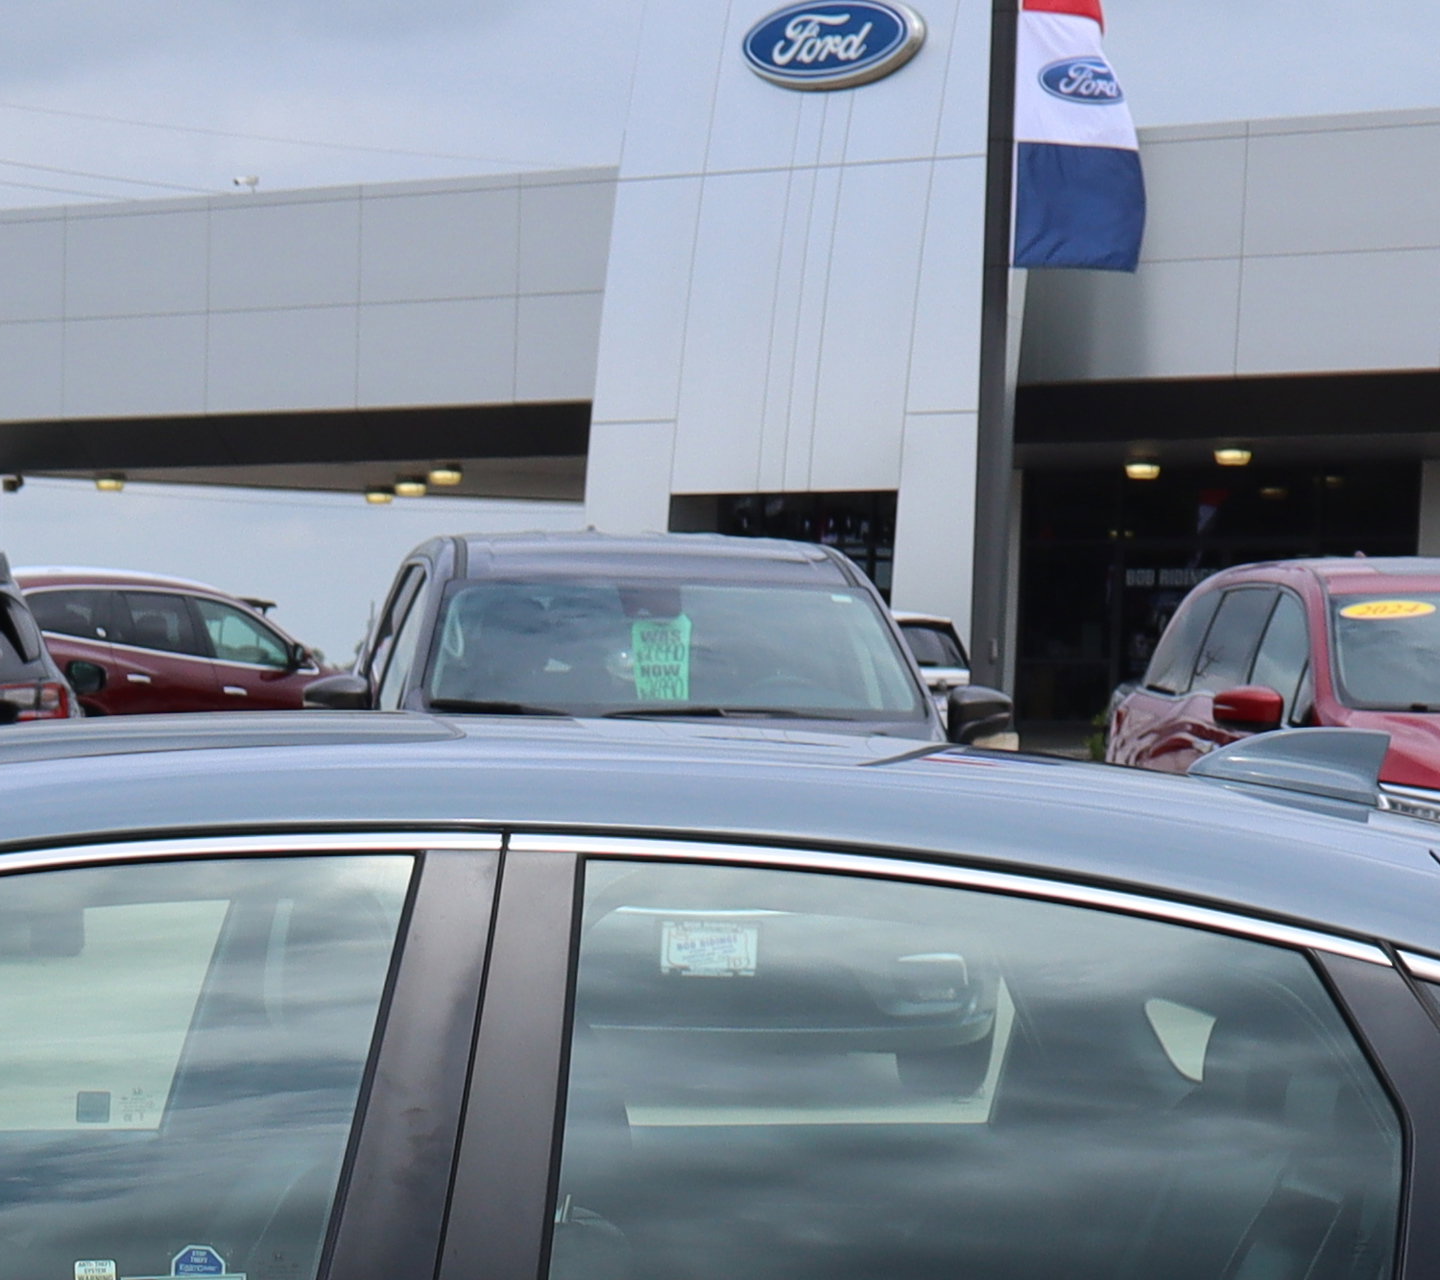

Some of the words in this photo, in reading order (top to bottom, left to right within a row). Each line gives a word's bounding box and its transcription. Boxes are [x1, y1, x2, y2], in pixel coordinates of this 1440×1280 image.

[772, 12, 873, 66] Ford
[1058, 62, 1120, 97] Ford
[1355, 603, 1423, 616] 2024
[640, 664, 681, 678] NOW
